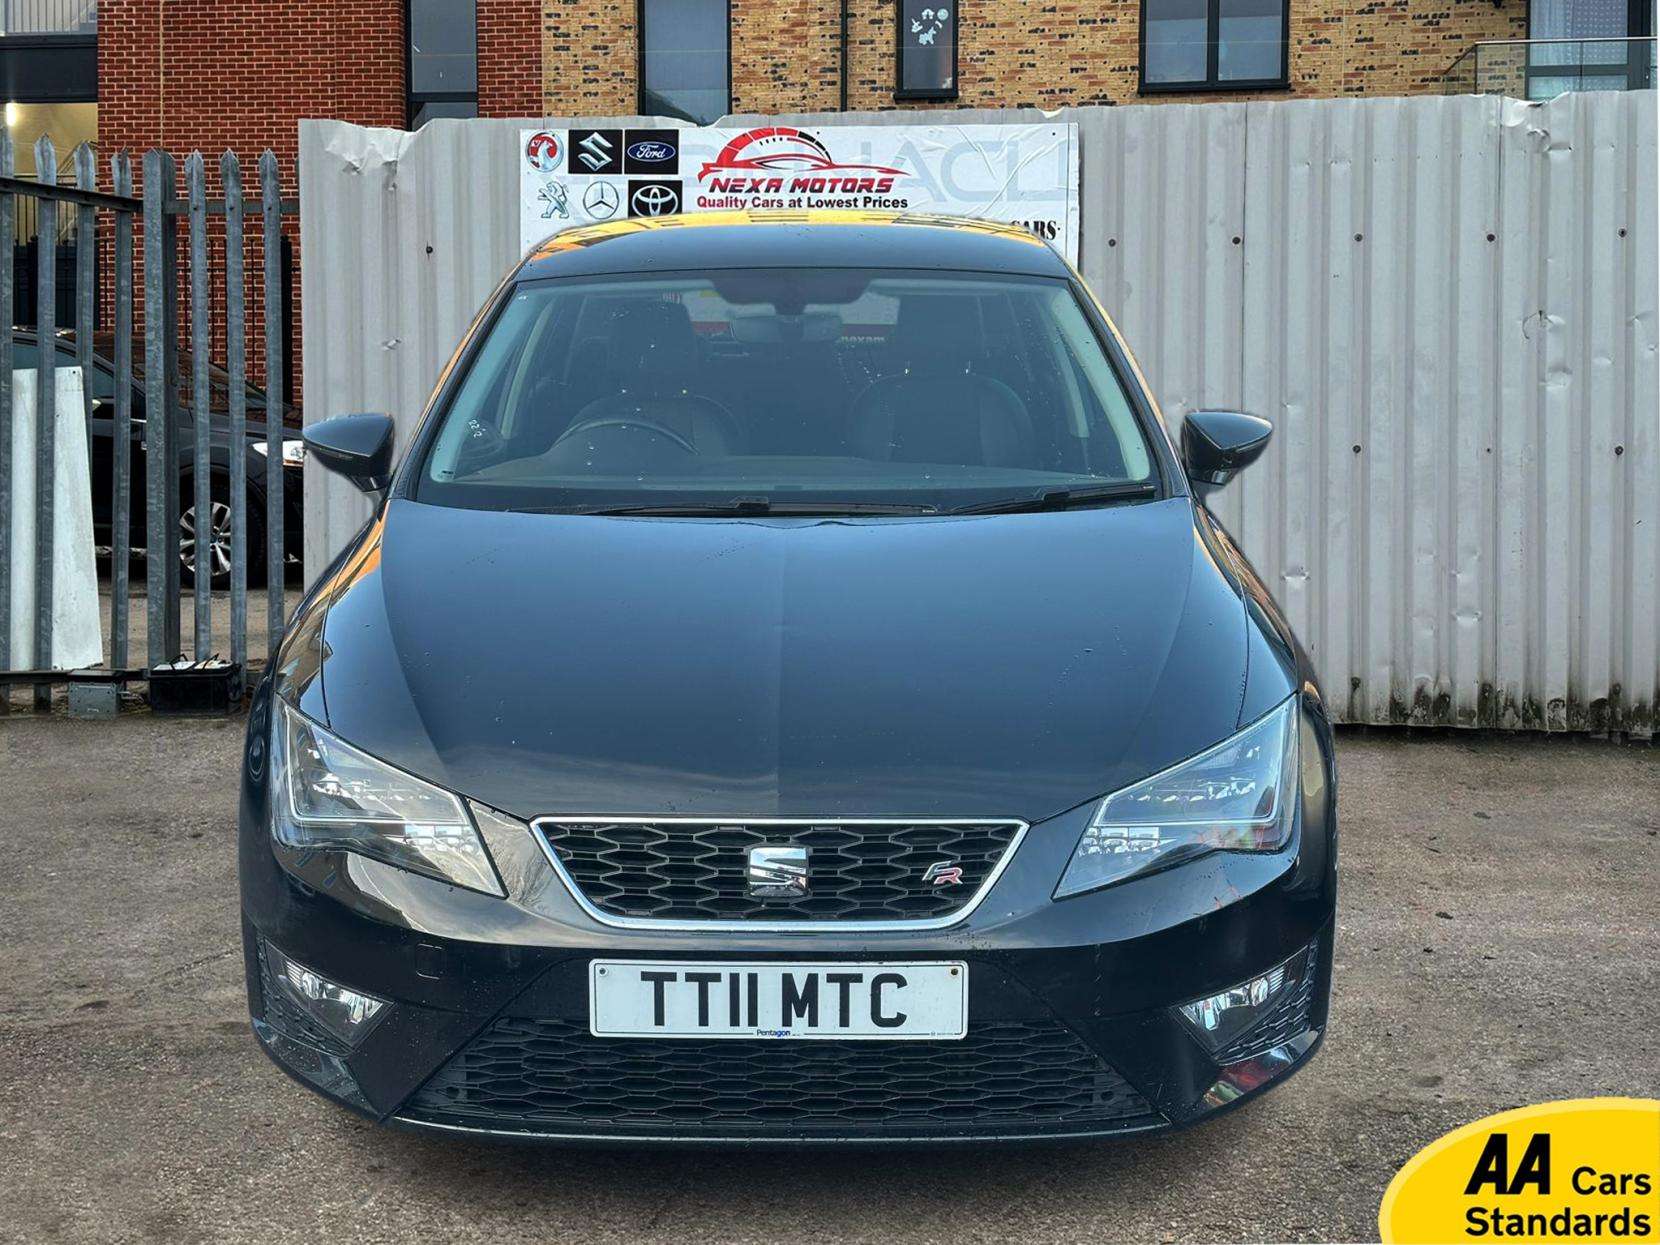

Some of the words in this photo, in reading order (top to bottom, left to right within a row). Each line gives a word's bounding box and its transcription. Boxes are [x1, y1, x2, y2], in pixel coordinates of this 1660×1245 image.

[636, 143, 666, 159] Ford
[709, 177, 784, 194] NEXA
[789, 177, 895, 194] MOTORS
[697, 195, 748, 210] Quality
[751, 195, 784, 208] Cars
[788, 196, 802, 208] at
[806, 195, 859, 208] Lowest
[862, 195, 908, 208] Prices
[1010, 219, 1057, 240] RS
[921, 859, 964, 885] FR
[781, 972, 908, 1028] MTC
[756, 1028, 791, 1038] Pentagon
